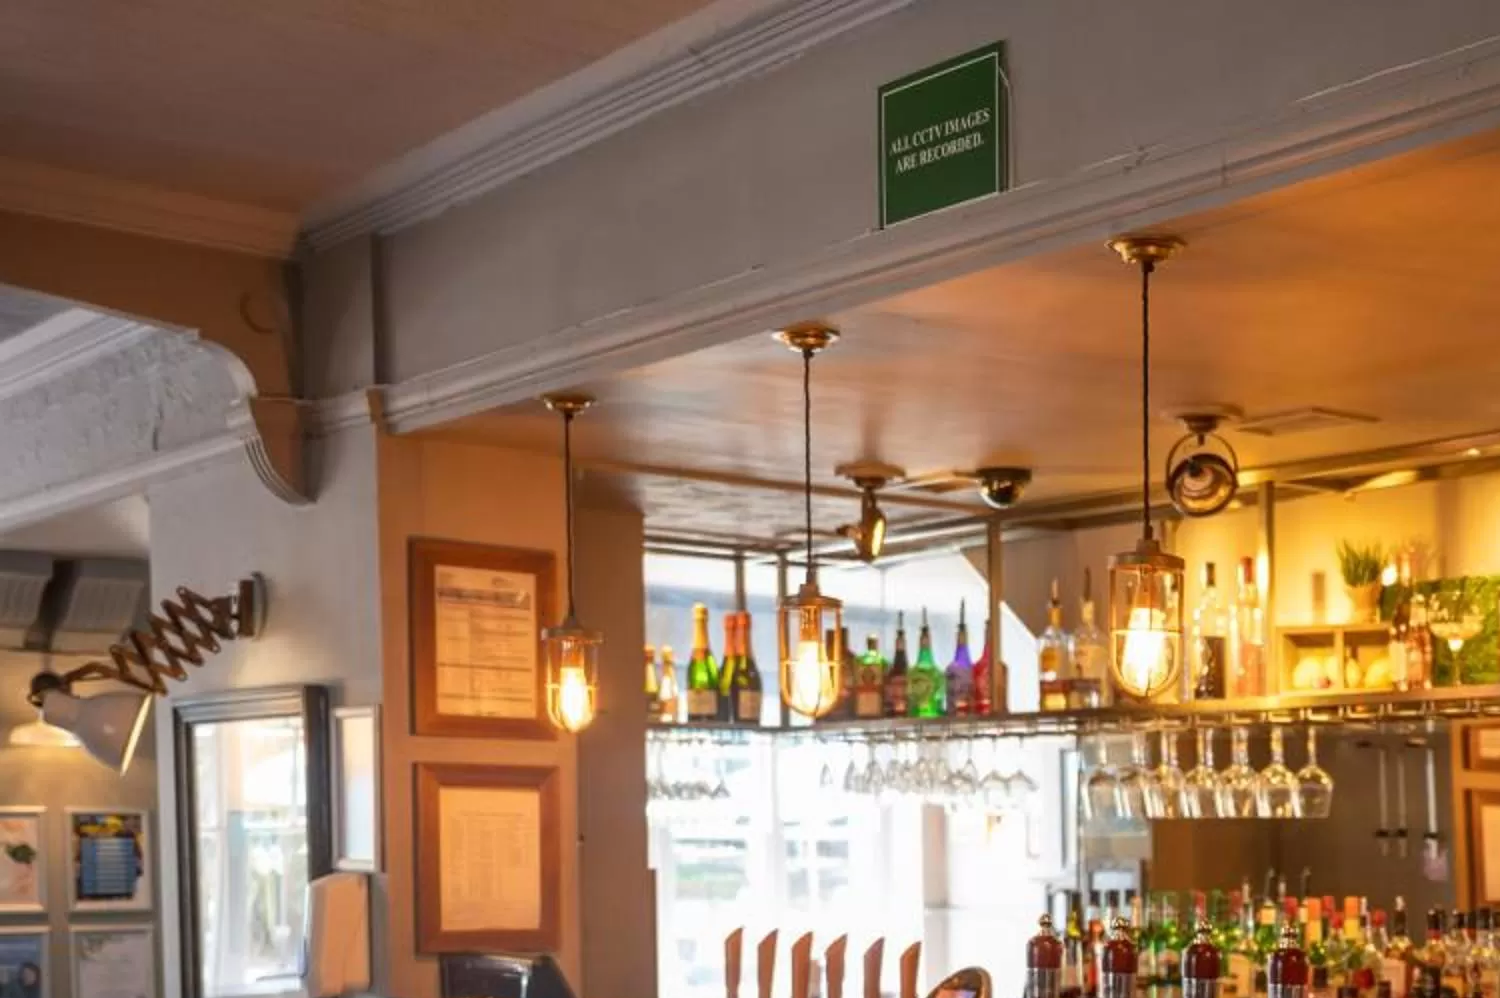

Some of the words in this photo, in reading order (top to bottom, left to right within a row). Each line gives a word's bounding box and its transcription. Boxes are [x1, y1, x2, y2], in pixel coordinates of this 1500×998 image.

[890, 137, 910, 155] ALL
[912, 125, 943, 147] CCTV
[944, 108, 991, 138] IMAGES
[895, 153, 918, 174] ARE
